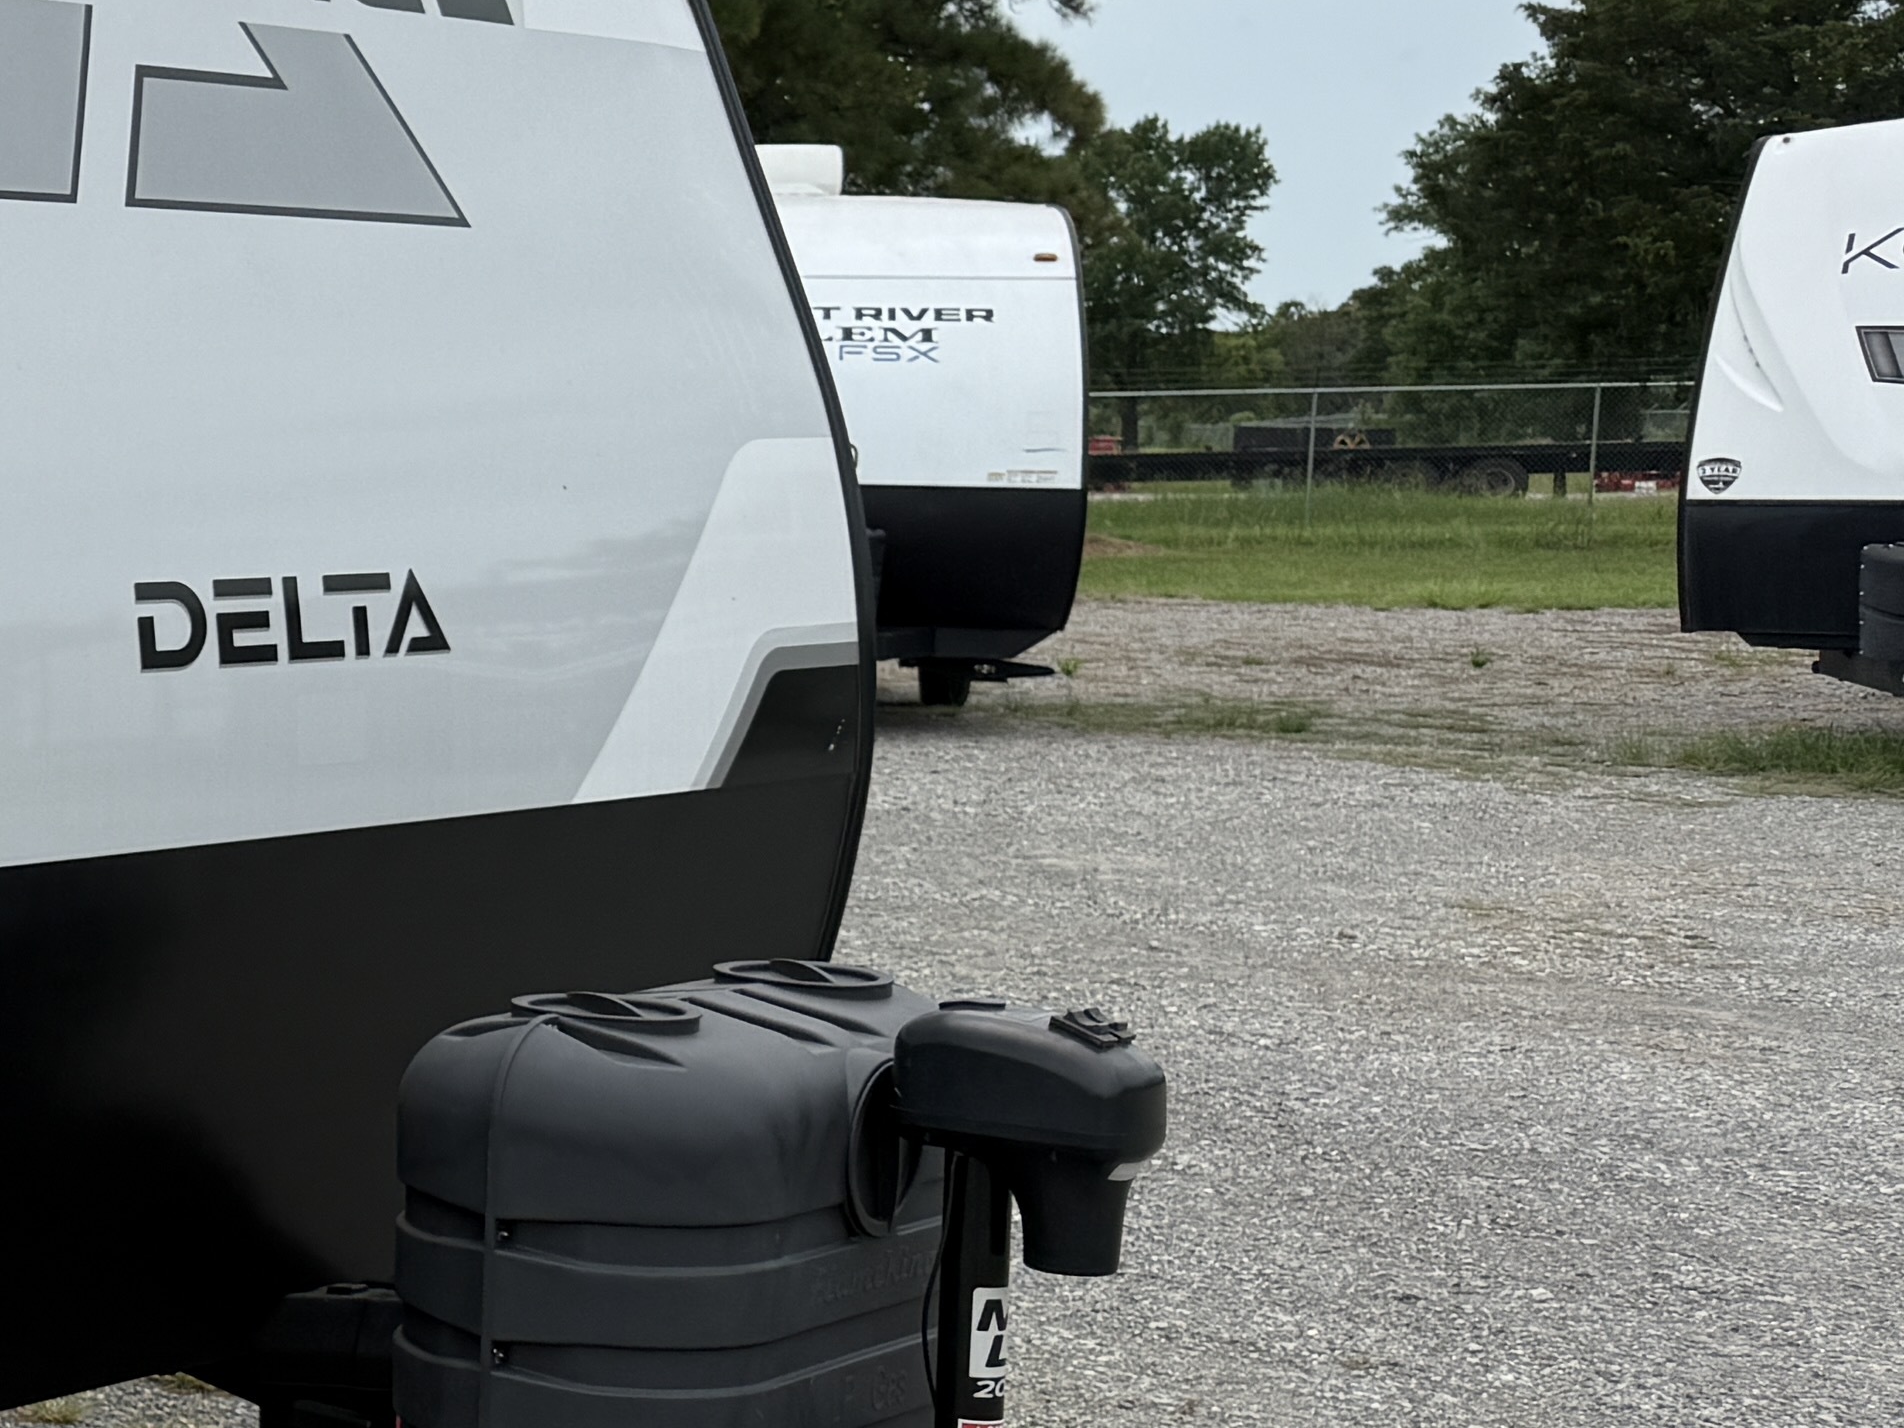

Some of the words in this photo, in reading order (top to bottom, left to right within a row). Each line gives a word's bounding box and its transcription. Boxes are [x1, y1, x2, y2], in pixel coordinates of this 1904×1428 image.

[852, 307, 995, 323] RIVER
[822, 326, 940, 343] EM
[839, 344, 940, 363] FSX
[134, 568, 451, 673] DELTA
